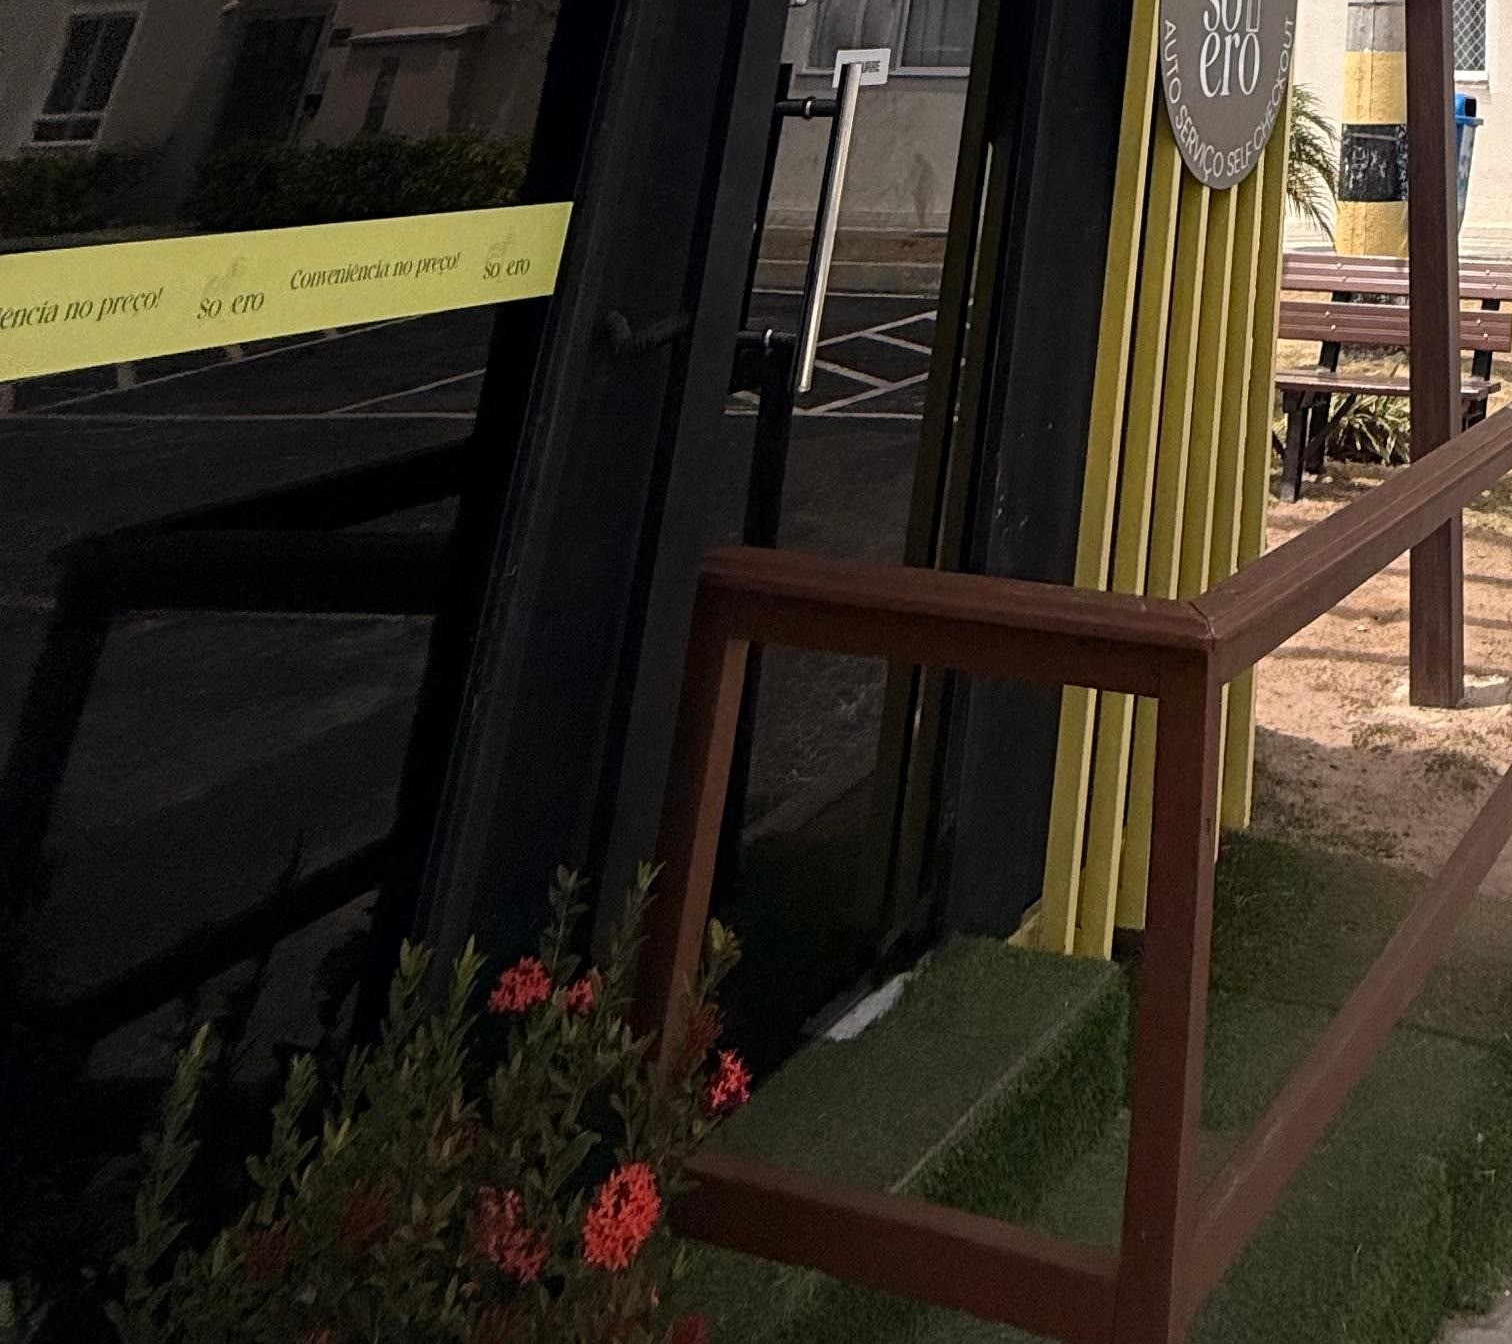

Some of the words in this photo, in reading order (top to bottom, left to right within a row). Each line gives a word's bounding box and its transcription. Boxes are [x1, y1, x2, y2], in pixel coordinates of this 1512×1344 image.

[1164, 19, 1183, 104] AUTO
[1175, 105, 1225, 182] SERVIÇO
[1226, 141, 1253, 177] SELF
[1253, 16, 1294, 150] CHECKOUT
[392, 262, 413, 279] no
[415, 251, 462, 279] preço!
[63, 298, 94, 322] no
[96, 287, 164, 322] preço!
